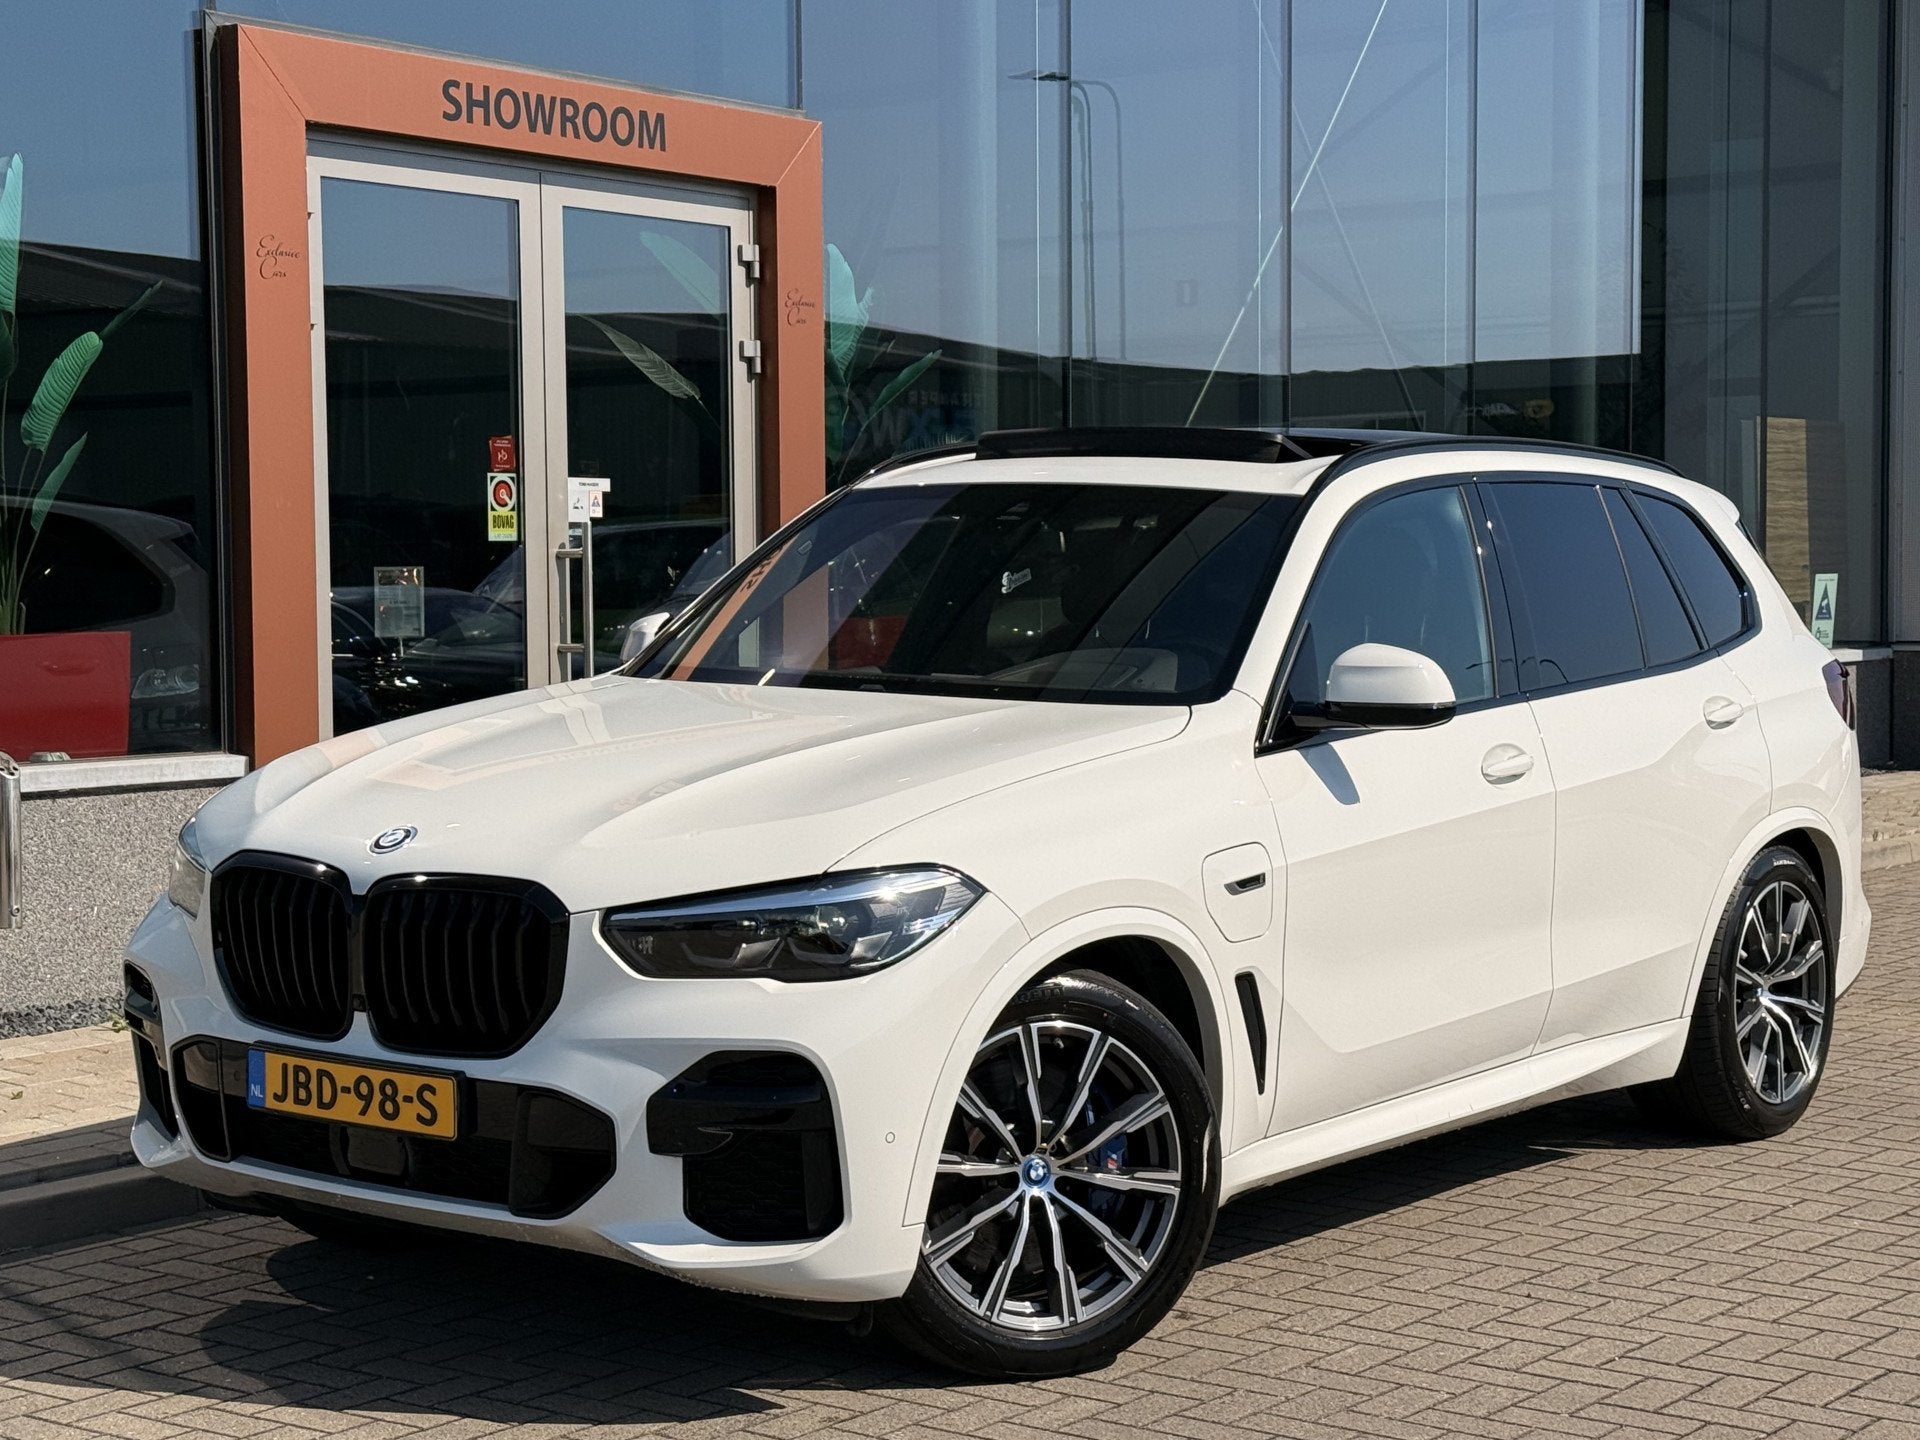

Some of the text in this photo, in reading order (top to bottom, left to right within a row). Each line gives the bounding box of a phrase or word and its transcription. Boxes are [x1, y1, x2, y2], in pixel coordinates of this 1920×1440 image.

[442, 79, 666, 152] SHOWROOM
[256, 234, 301, 259] Exclusive
[260, 256, 287, 280] Cars
[492, 514, 515, 530] BOVAG
[250, 1062, 438, 1127] NL JBD-98-S
